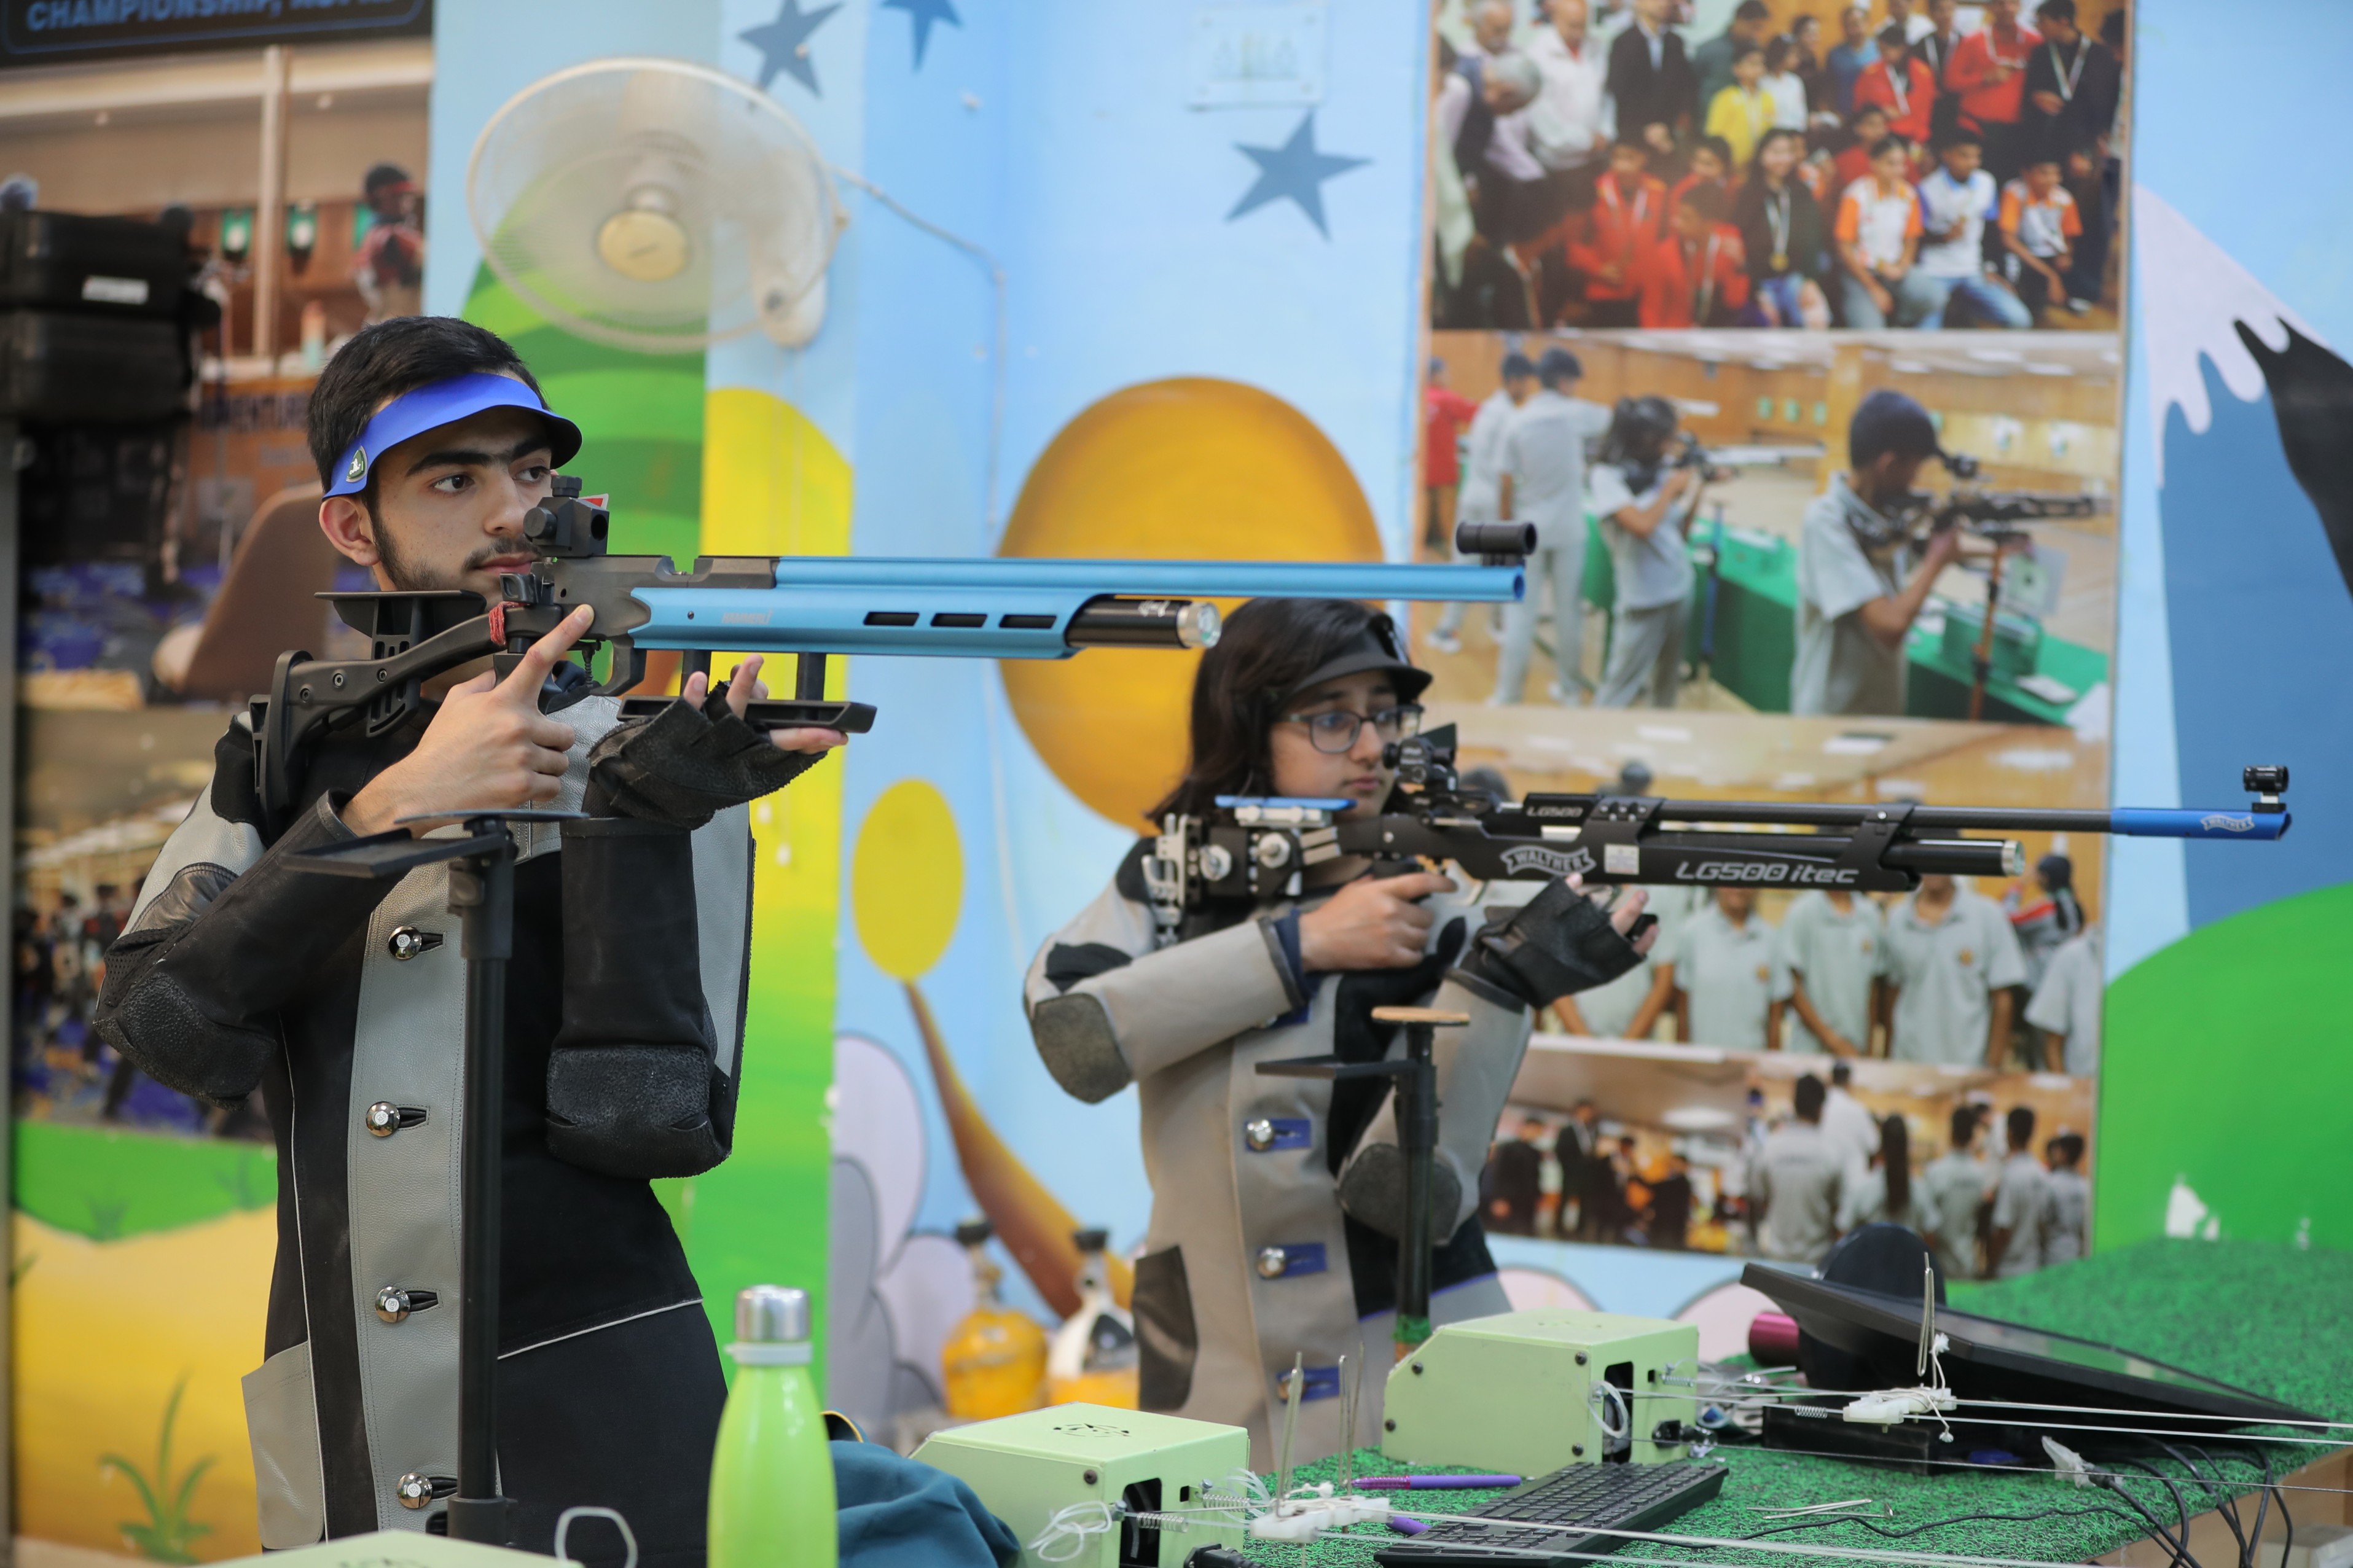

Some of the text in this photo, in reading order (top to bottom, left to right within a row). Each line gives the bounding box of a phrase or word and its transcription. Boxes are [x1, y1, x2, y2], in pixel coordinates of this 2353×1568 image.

[1526, 806, 1584, 817] LG500
[1514, 849, 1584, 872] WALTHER
[1675, 861, 1860, 884] LG500 itec
